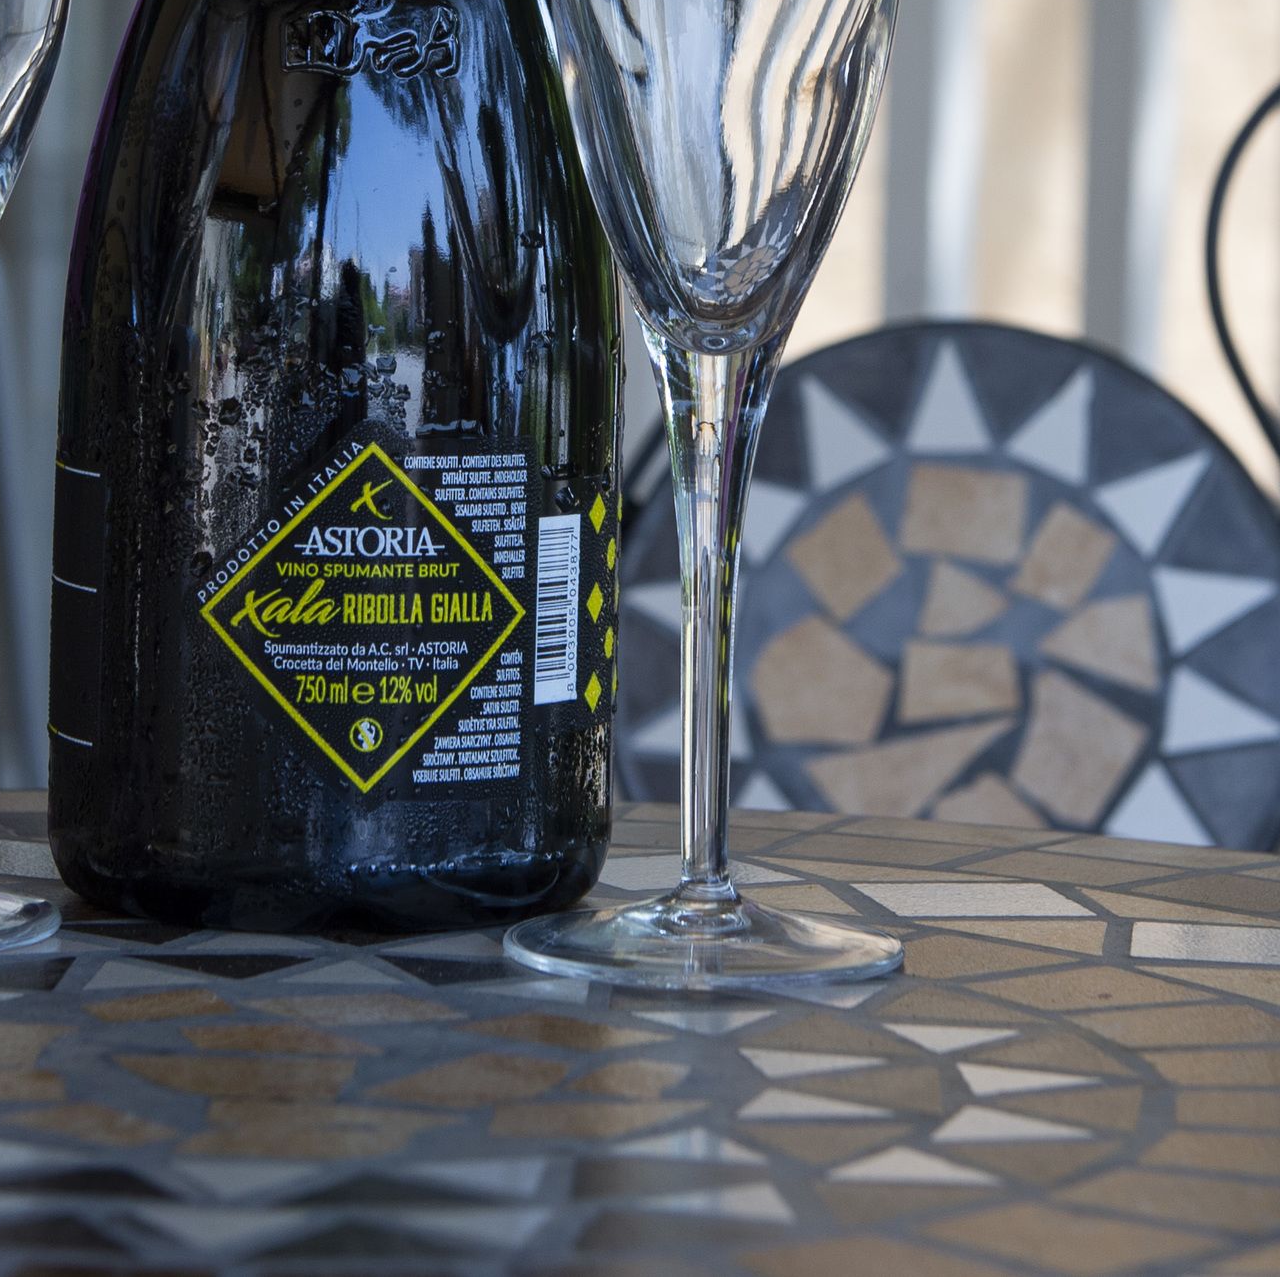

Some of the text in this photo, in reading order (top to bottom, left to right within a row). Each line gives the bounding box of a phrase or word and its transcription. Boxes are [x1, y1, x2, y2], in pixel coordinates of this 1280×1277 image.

[491, 454, 501, 467] DES
[197, 441, 364, 603] PRODOTTO IN ITALIA
[294, 526, 445, 557] ASTORIA
[276, 562, 460, 578] VINO SPUMANTE BRUT
[343, 593, 423, 624] RIBOLLA
[431, 591, 493, 623] GIALLA
[567, 534, 578, 691] 8 003905 043877
[264, 640, 468, 657] Spumantizzato da A.C. srl ASTORIA
[274, 655, 459, 671] Crocetta del Montello TV Italia
[296, 675, 326, 703] 750
[330, 675, 348, 703] ml
[379, 675, 413, 704] 12%
[415, 675, 438, 703] vol
